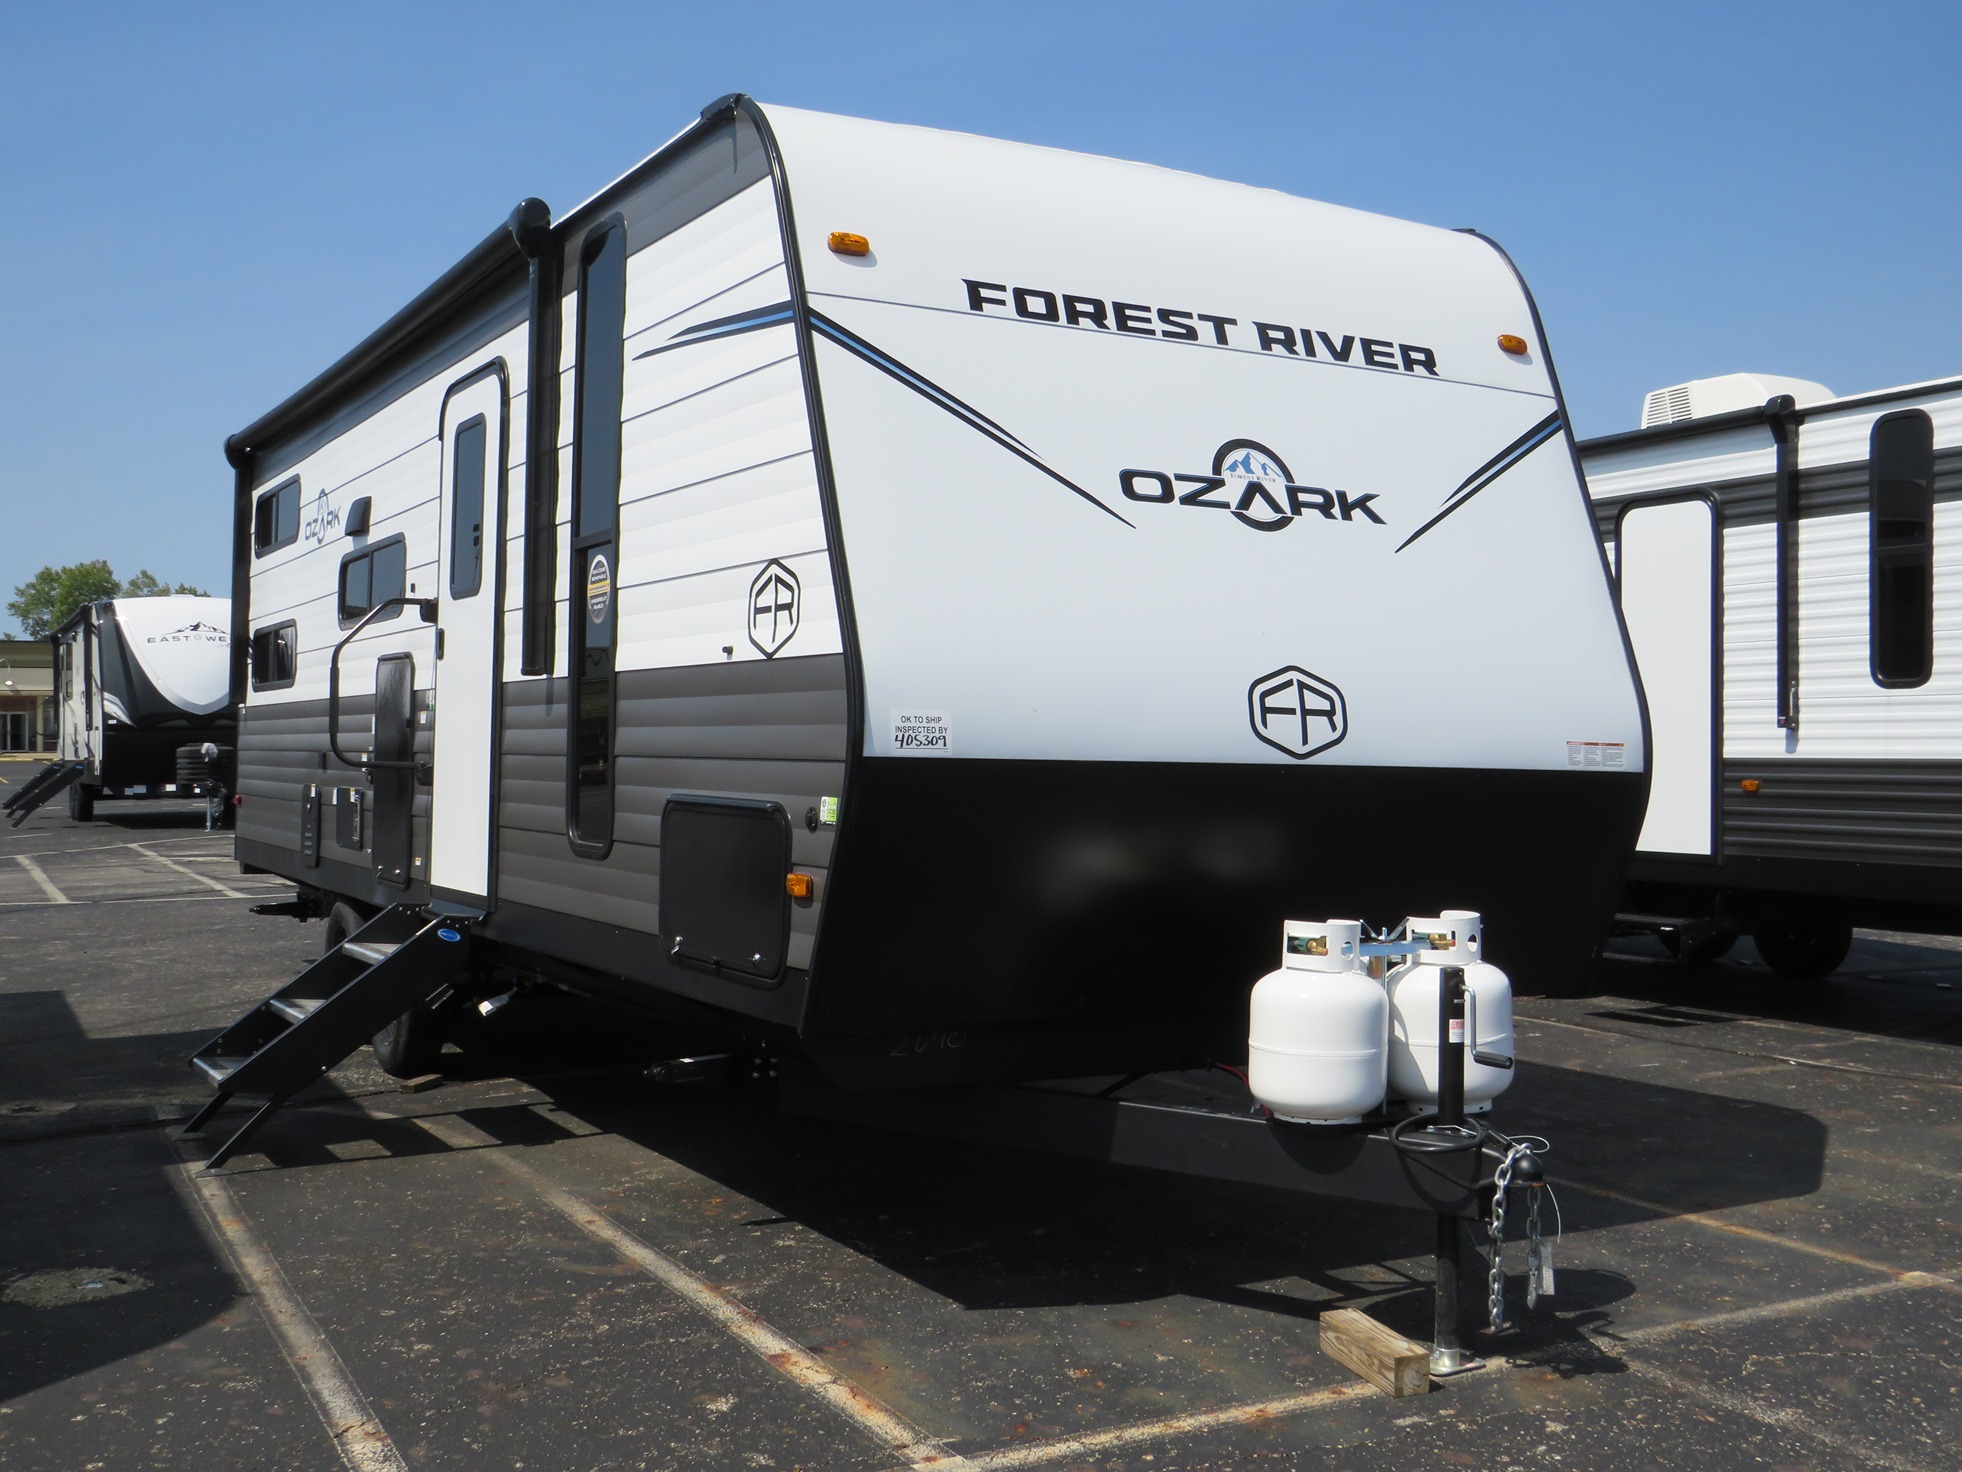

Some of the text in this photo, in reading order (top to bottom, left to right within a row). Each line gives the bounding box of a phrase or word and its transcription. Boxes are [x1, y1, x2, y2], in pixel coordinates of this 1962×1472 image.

[961, 278, 1440, 377] FOREST RIVER
[1118, 468, 1388, 526] OZARK
[305, 505, 341, 541] OZARK
[147, 635, 191, 644] EAST
[895, 725, 948, 734] INSPECTED BY
[900, 715, 942, 724] OK TO SHIP
